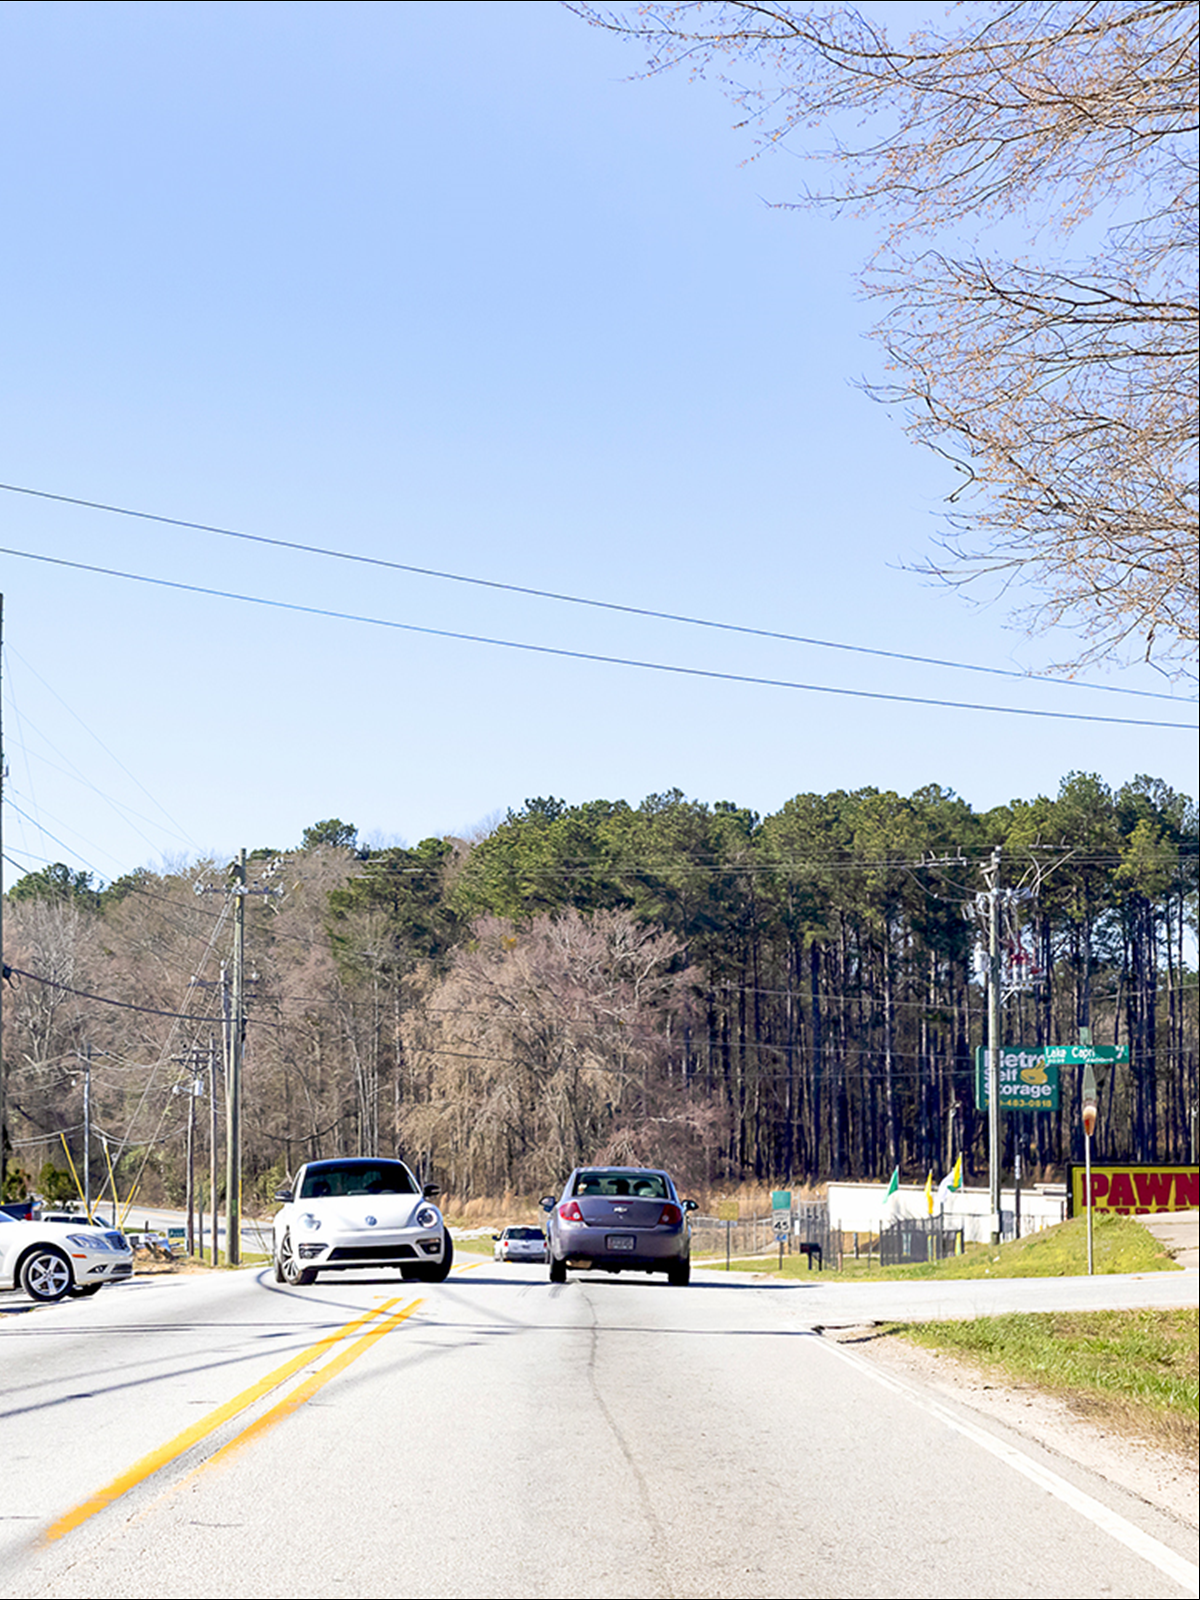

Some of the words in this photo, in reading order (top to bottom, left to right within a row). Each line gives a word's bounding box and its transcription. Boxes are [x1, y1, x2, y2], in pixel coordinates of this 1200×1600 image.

[1045, 1047, 1067, 1058] Lake
[1081, 1173, 1199, 1206] PAWN
[774, 1221, 789, 1230] 45
